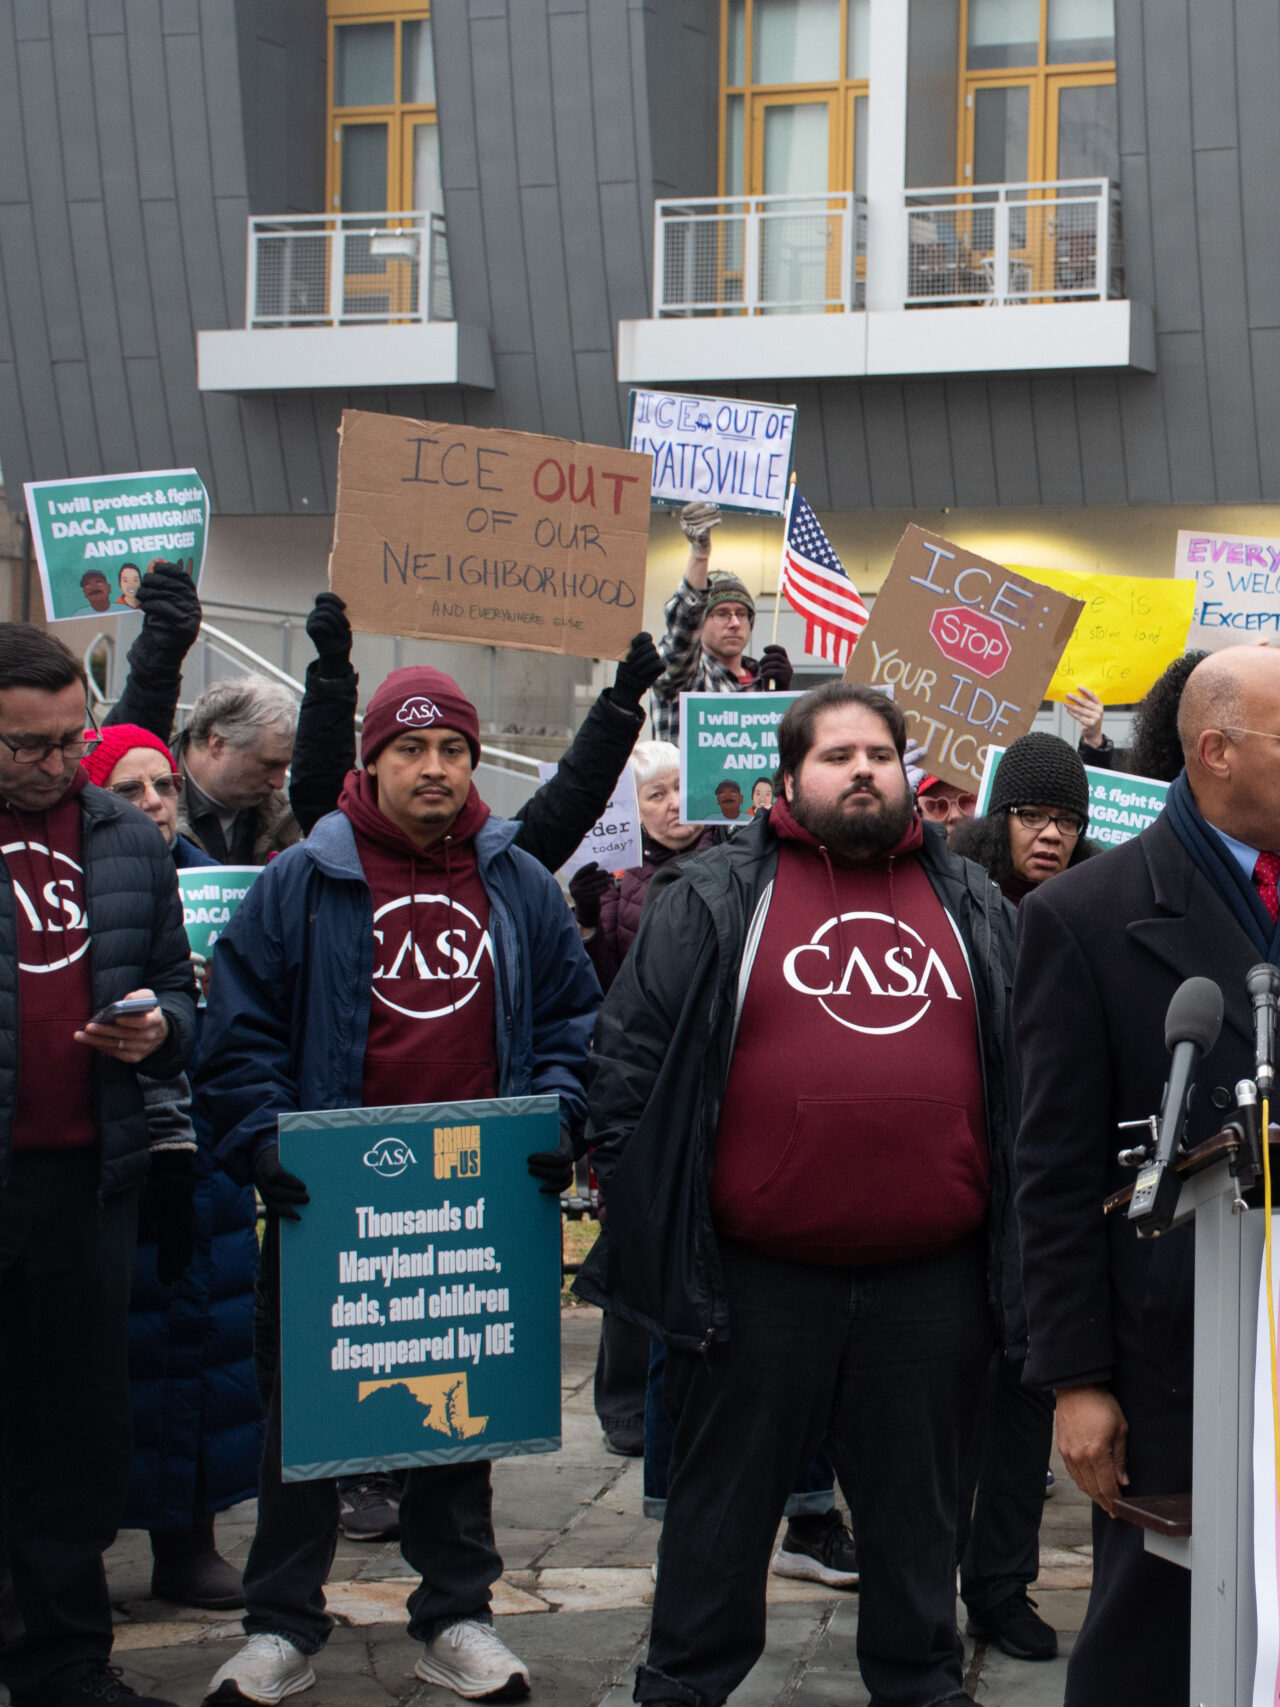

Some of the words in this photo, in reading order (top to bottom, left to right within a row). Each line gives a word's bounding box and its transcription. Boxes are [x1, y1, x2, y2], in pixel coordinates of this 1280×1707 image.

[638, 392, 700, 432] ICE
[716, 406, 764, 436] OUT
[765, 413, 792, 440] OF
[401, 438, 509, 492] ICE
[533, 458, 639, 515] OUT
[48, 500, 55, 515] I
[57, 497, 91, 514] will
[93, 490, 153, 514] protect
[155, 489, 167, 502] &
[167, 487, 192, 505] fight
[51, 518, 115, 538] DACA,
[116, 508, 203, 532] IMMIGRANTS,
[466, 507, 518, 533] OF
[534, 518, 607, 557] OUR
[84, 540, 128, 559] AND
[129, 531, 195, 553] REFUGEES
[383, 541, 636, 608] NEIGHBORHOOD
[1195, 570, 1215, 589] IS
[431, 601, 464, 618] AND
[553, 617, 583, 630] ELSE
[940, 614, 1003, 660] STOP
[871, 640, 937, 704] YOUR
[396, 702, 443, 722] CASA
[699, 711, 704, 725] I
[707, 711, 738, 726] will
[698, 732, 758, 750] DACA,
[723, 754, 767, 769] AND
[1094, 785, 1107, 800] &
[1109, 788, 1147, 808] fight
[1148, 797, 1166, 811] fo
[1088, 803, 1157, 830] IGRANT
[592, 839, 633, 853] today?
[1085, 824, 1140, 845] UGEE
[186, 885, 219, 901] will
[222, 886, 251, 903] pro
[183, 907, 230, 924] DACA
[373, 928, 495, 980] ASA
[783, 944, 962, 1000] CASA
[434, 1125, 480, 1153] BRAVE
[363, 1147, 418, 1167] CASA
[434, 1152, 457, 1180] OF
[459, 1149, 479, 1176] US
[355, 1200, 461, 1239] Thousands
[465, 1197, 485, 1229] of
[339, 1244, 434, 1287] Maryland
[437, 1246, 501, 1273] moms,
[331, 1293, 385, 1327] dads,
[389, 1288, 425, 1322] and
[428, 1283, 509, 1319] children
[331, 1328, 454, 1374] disappeared
[458, 1327, 482, 1365] by
[485, 1322, 515, 1356] ICE
